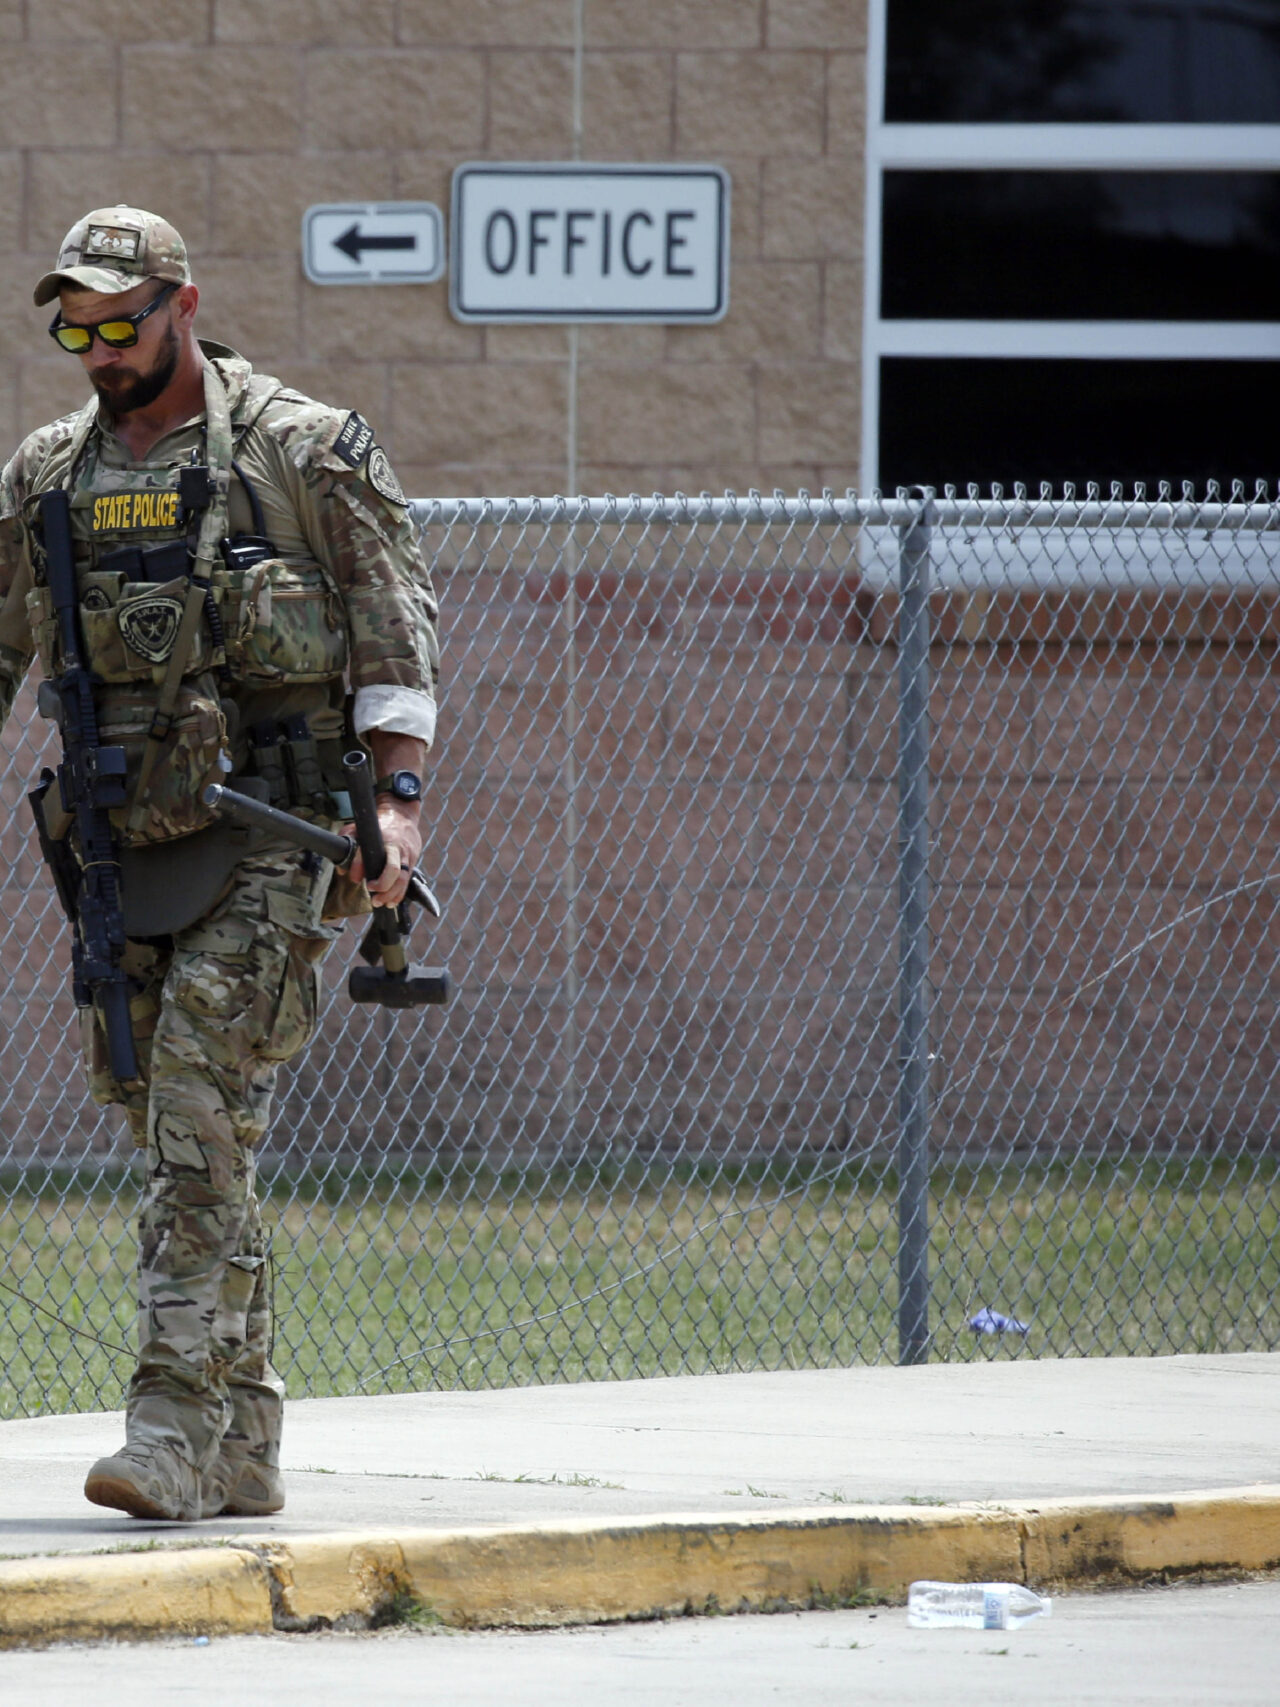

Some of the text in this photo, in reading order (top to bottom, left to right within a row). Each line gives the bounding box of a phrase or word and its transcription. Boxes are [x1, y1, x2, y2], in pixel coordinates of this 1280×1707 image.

[484, 208, 697, 277] OFFICE
[341, 418, 358, 444] STATE
[349, 425, 373, 461] POLICE
[93, 493, 179, 531] STATE POLICE
